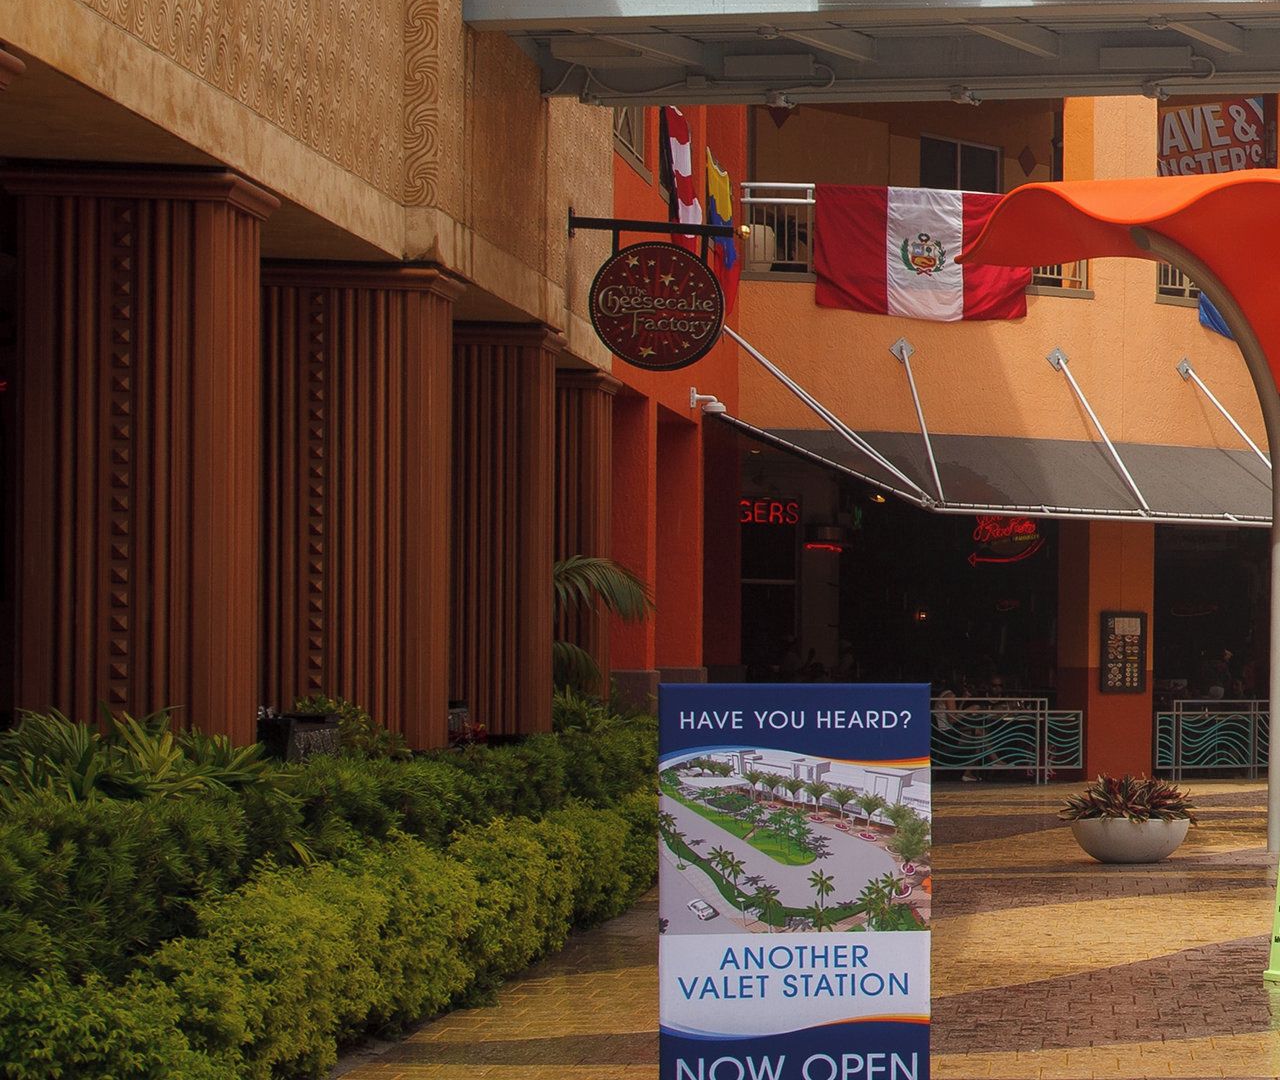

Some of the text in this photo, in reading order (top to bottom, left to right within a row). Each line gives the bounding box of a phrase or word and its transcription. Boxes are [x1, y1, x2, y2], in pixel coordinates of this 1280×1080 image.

[1162, 104, 1261, 157] AVE &
[598, 285, 715, 318] Cheesecake
[622, 285, 648, 296] The
[622, 308, 713, 340] Factory
[738, 499, 801, 526] GERS
[679, 710, 912, 730] HAVE YOU HEARD?
[719, 944, 869, 971] ANOTHER
[678, 972, 910, 1000] VALET STATION
[676, 1051, 919, 1080] NOW OPEN
